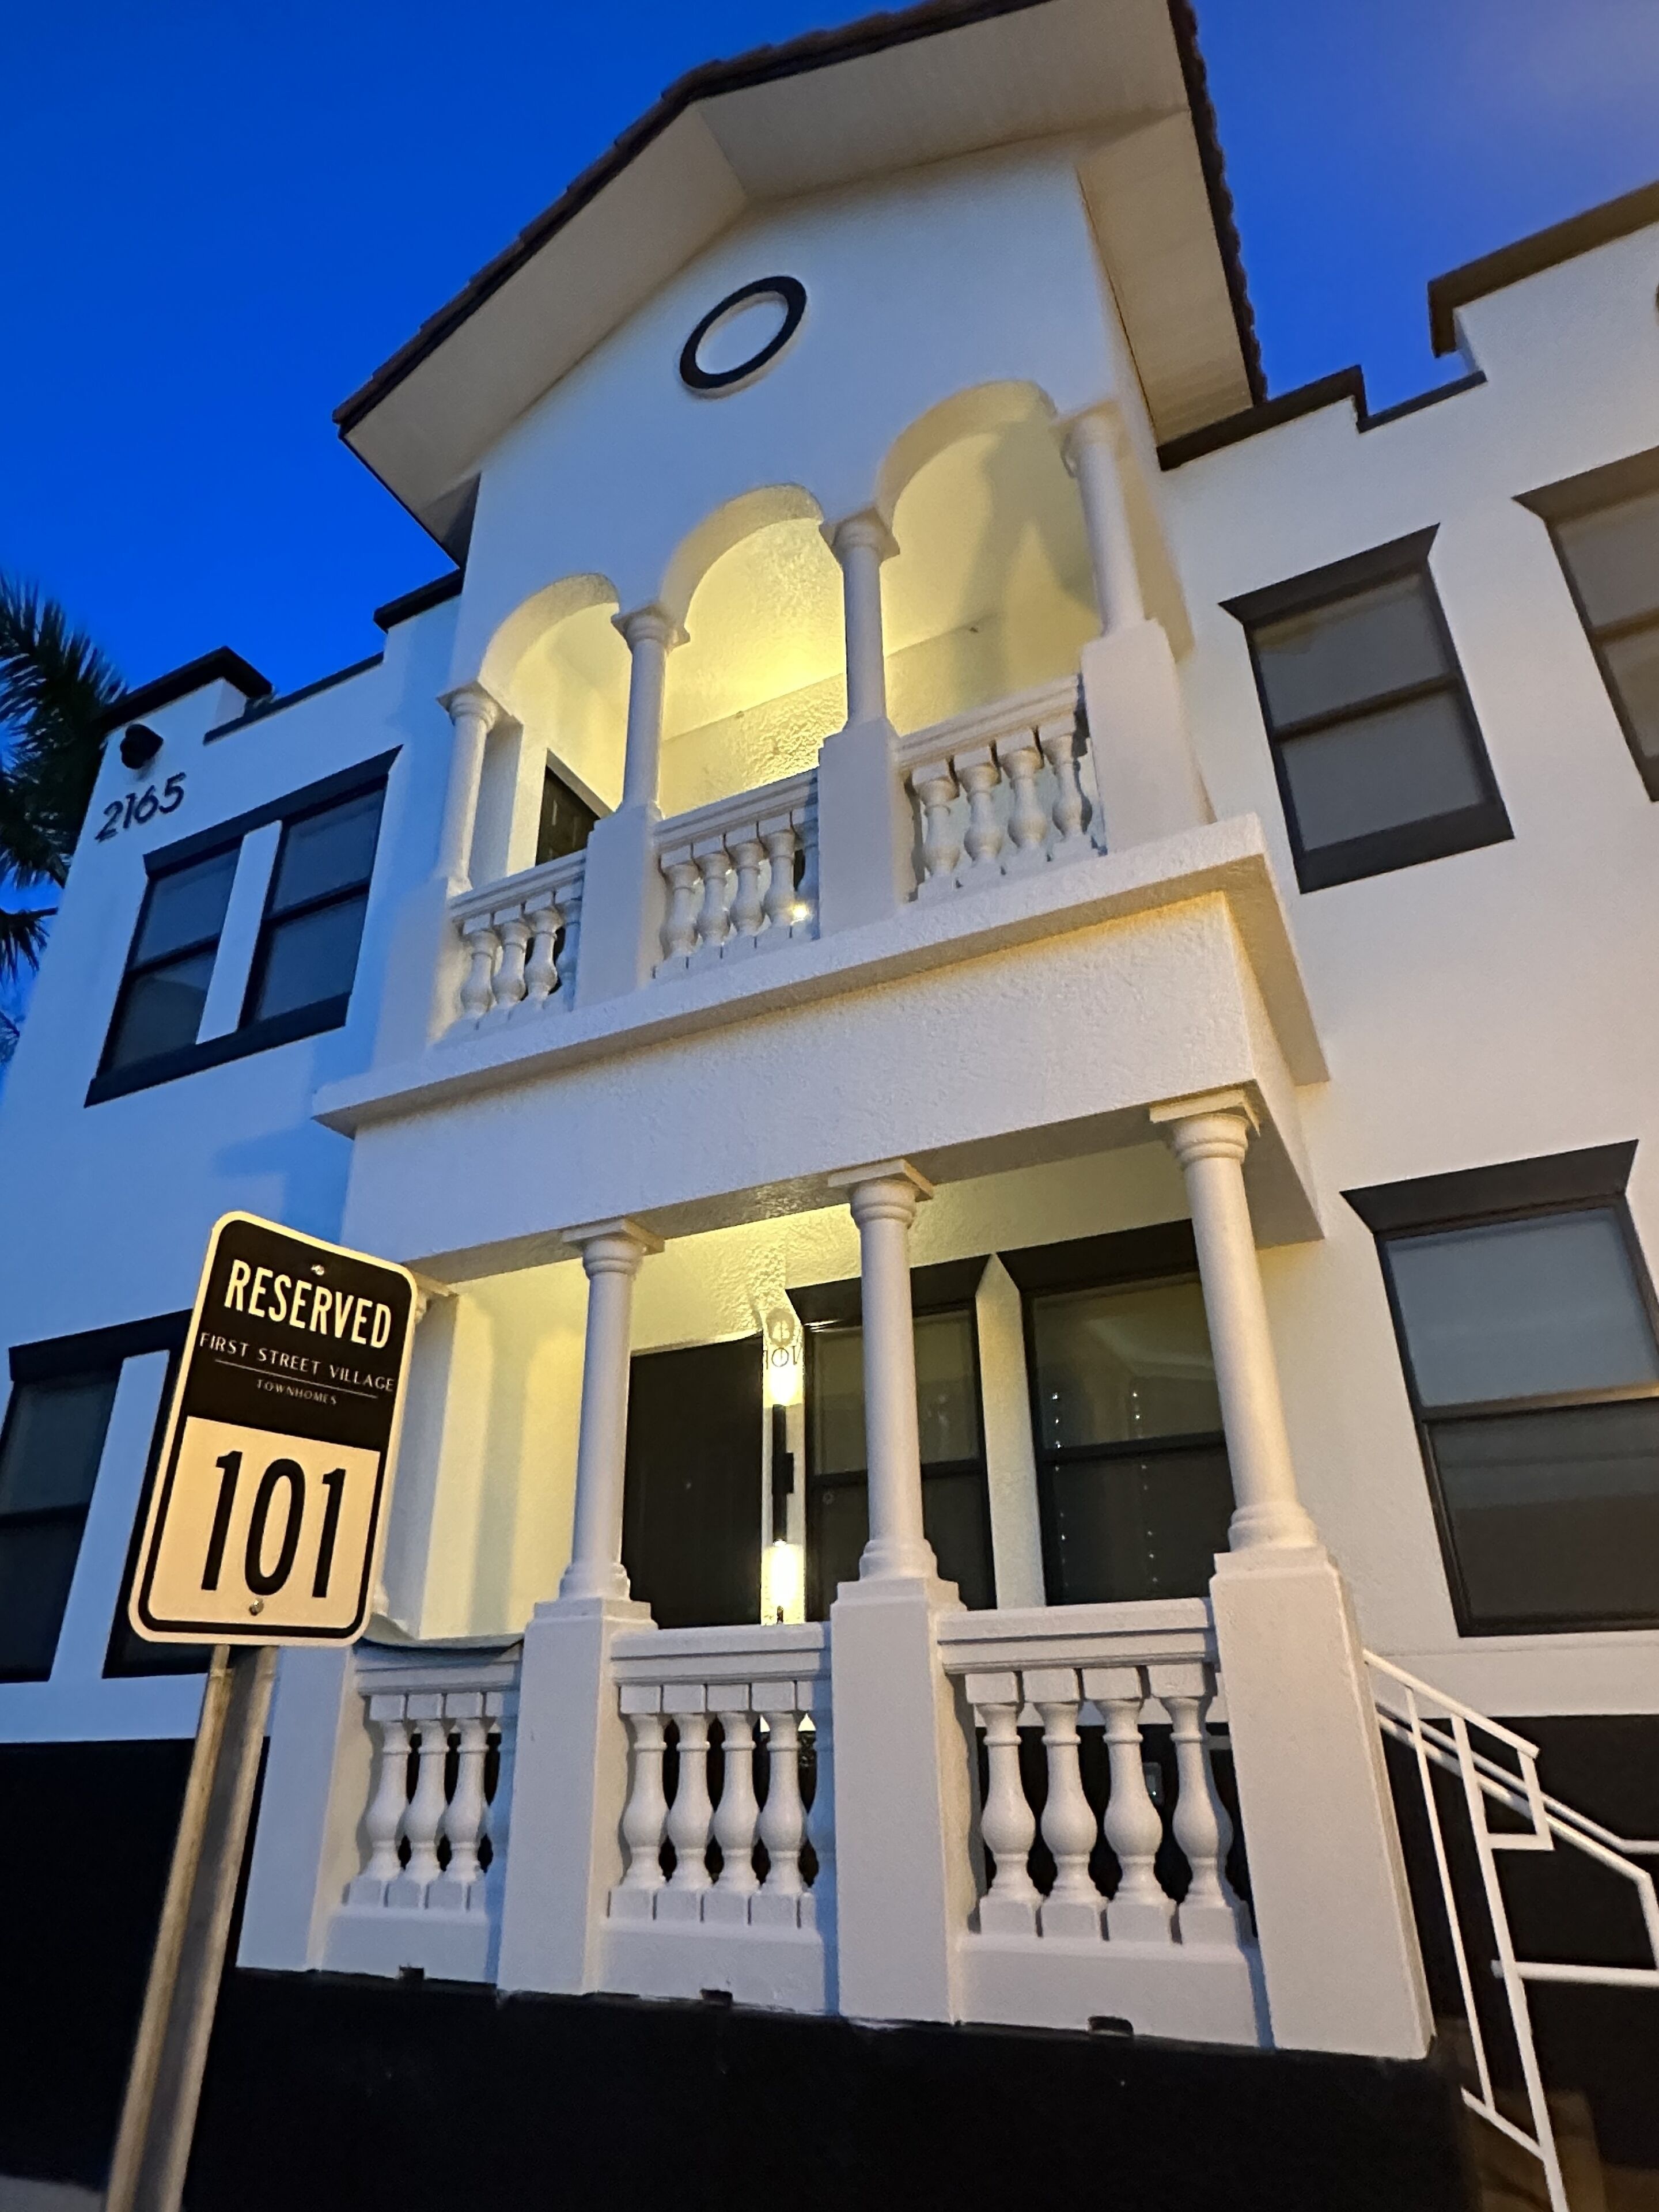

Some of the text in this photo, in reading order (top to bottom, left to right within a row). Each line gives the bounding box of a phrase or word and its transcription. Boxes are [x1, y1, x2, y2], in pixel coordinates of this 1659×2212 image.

[95, 772, 186, 842] 2165
[224, 1259, 392, 1349] RESERVED
[199, 1332, 395, 1392] FIRST STREET VILLAGE
[256, 1379, 337, 1406] TOWNHOMES
[201, 1450, 346, 1599] 101
